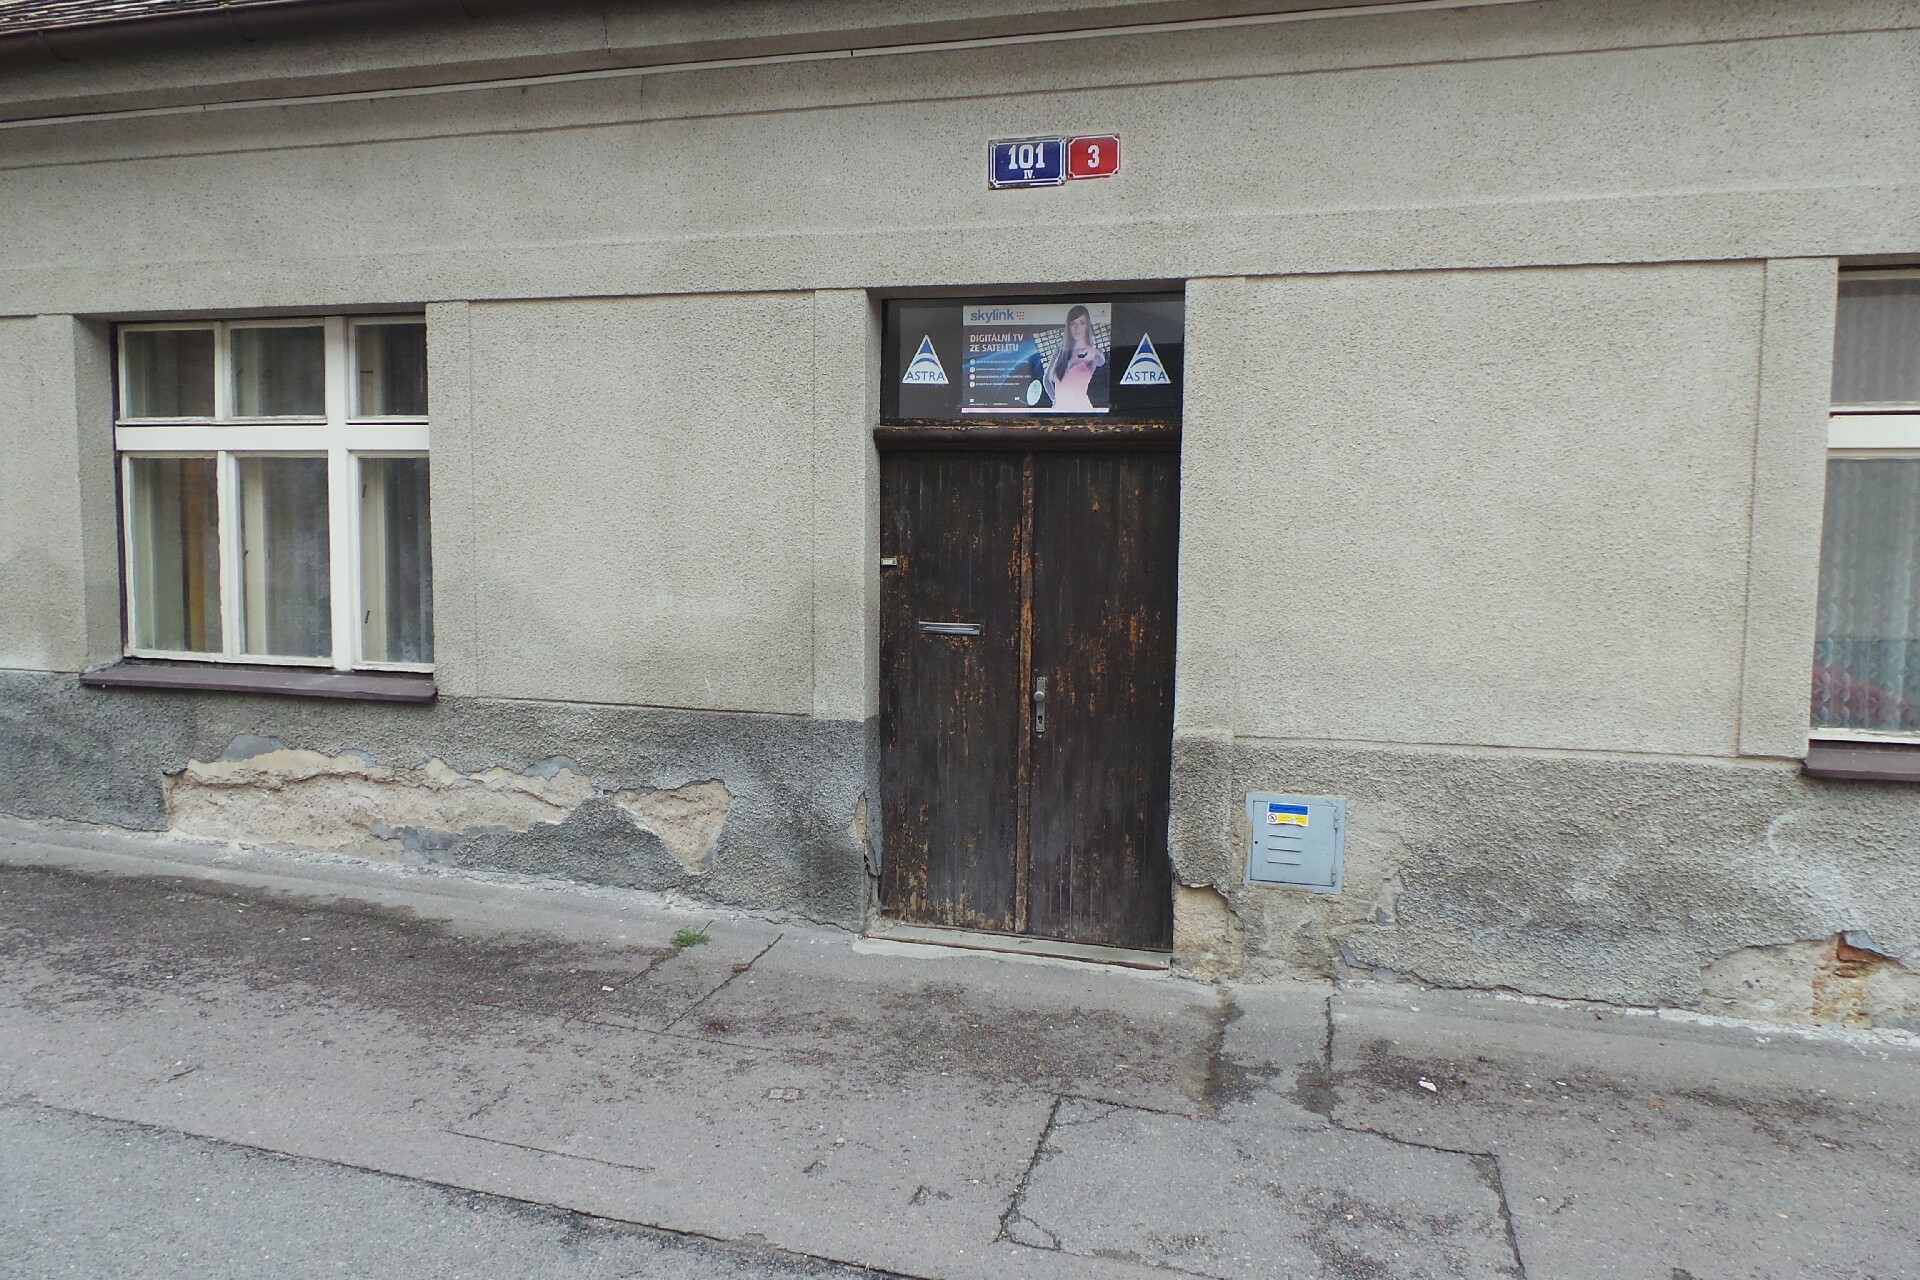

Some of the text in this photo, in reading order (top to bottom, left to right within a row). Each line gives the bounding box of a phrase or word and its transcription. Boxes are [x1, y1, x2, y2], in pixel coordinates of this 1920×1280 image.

[1008, 142, 1046, 170] 101
[1087, 144, 1100, 168] 3
[1023, 169, 1036, 179] IV.
[970, 309, 1014, 323] skylink
[970, 333, 1024, 343] DIGITÁLNÍ TV
[969, 343, 1019, 352] ZE SATELITU
[906, 371, 945, 381] ASTRA
[1125, 371, 1166, 382] ASTRA
